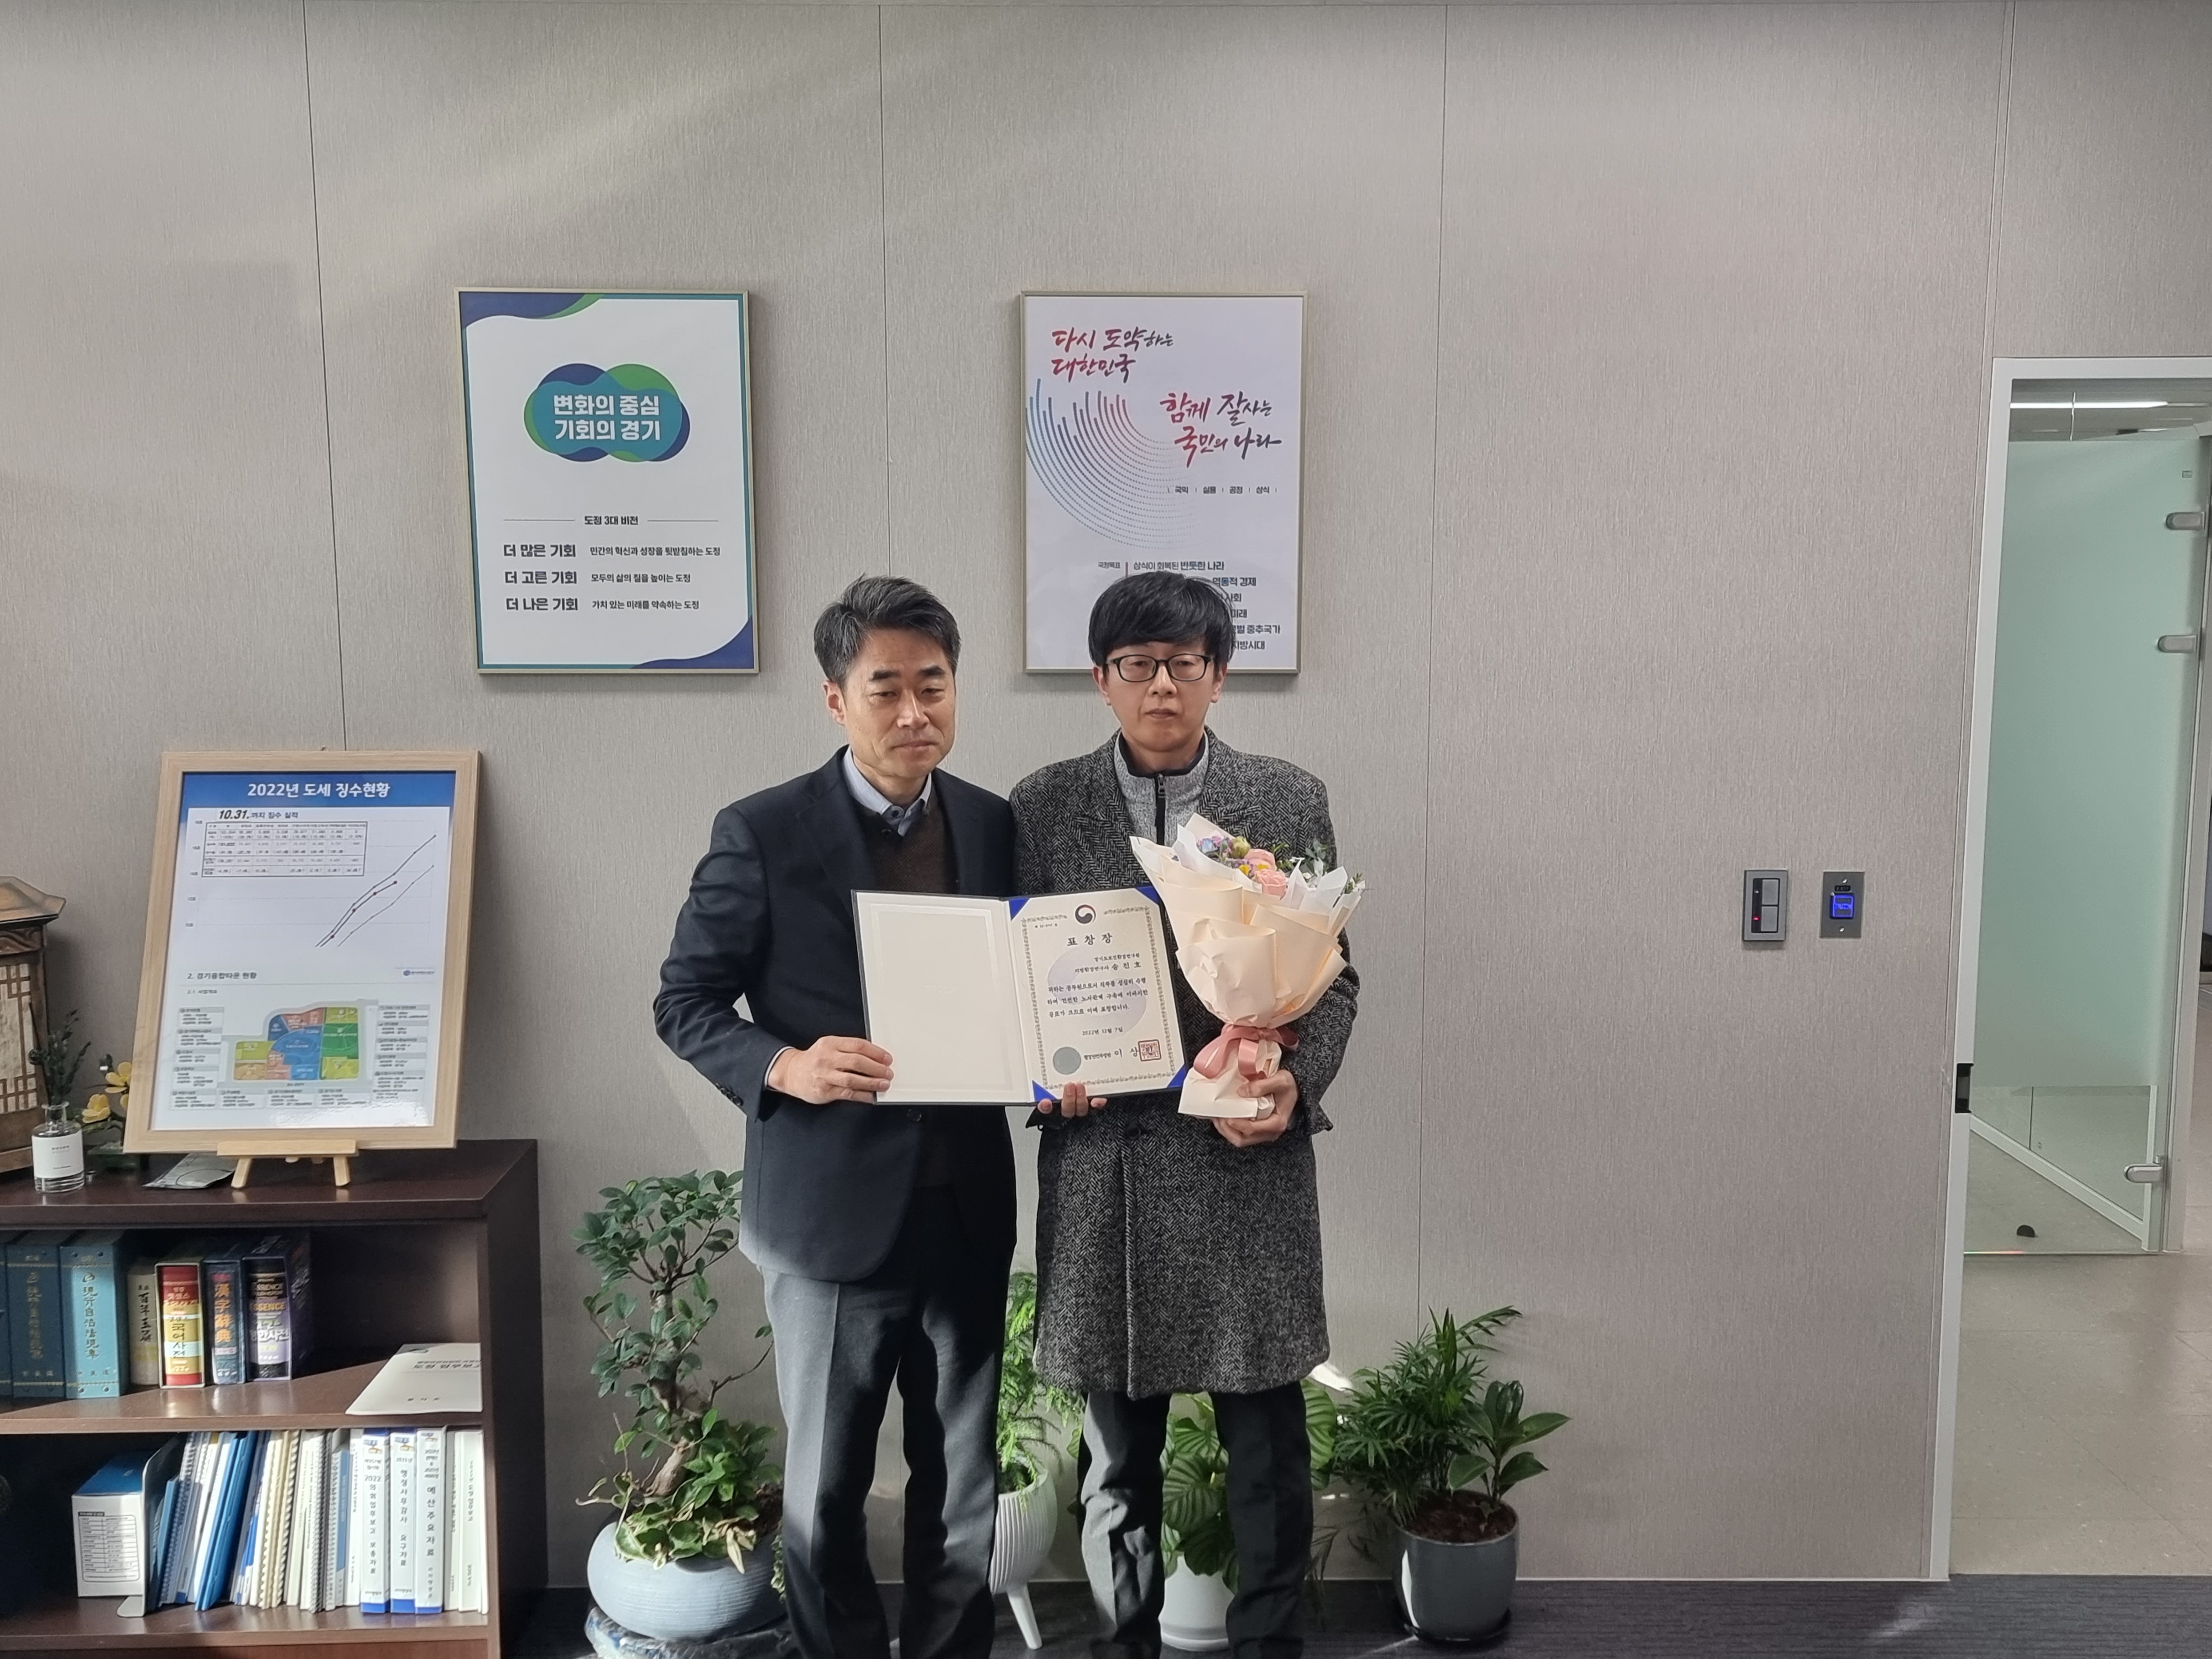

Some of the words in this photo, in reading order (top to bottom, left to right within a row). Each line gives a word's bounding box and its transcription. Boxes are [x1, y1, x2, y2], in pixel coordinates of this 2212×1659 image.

[1052, 327, 1096, 353] 다시
[1103, 326, 1174, 352] 도약하는
[1051, 353, 1136, 384] 대한민국
[554, 394, 614, 415] 변화의
[619, 395, 660, 415] 중심
[1160, 392, 1211, 424] 함께
[1217, 390, 1272, 427] 잘사는
[555, 419, 615, 440] 기회의
[620, 420, 660, 441] 경기
[1174, 426, 1228, 468] 국민의
[1234, 427, 1282, 460] 나라
[585, 515, 602, 525] 도정
[604, 516, 618, 525] 3대
[621, 516, 638, 525] 비전
[503, 544, 516, 557] 더
[520, 544, 546, 557] 많은
[550, 544, 576, 557] 기회
[590, 546, 613, 556] 민간의
[615, 546, 638, 556] 혁신과
[640, 546, 662, 556] 성장을
[665, 546, 703, 556] 뒷받침하는
[705, 546, 720, 556] 도정
[1133, 561, 1156, 570] 상식이
[1157, 561, 1179, 570] 회복된
[1180, 561, 1206, 571] 반듯한
[1207, 561, 1225, 571] 나라
[505, 571, 517, 584] 더
[521, 571, 547, 584] 고른
[551, 571, 577, 584] 기회
[591, 573, 614, 583] 모두의
[616, 573, 632, 583] 삶의
[633, 573, 649, 583] 질을
[650, 573, 674, 583] 높이는
[675, 573, 691, 583] 도정
[1240, 577, 1256, 587] 경제
[506, 598, 519, 611] 더
[523, 598, 549, 611] 나은
[553, 598, 578, 611] 기회
[592, 600, 607, 609] 가치
[609, 600, 625, 609] 있는
[627, 600, 649, 609] 미래를
[651, 600, 682, 609] 약속하는
[684, 600, 700, 609] 도정
[1247, 625, 1280, 634] 중추국가
[248, 783, 299, 797] 2022년
[303, 783, 331, 797] 도세
[336, 782, 390, 797] 징수현황
